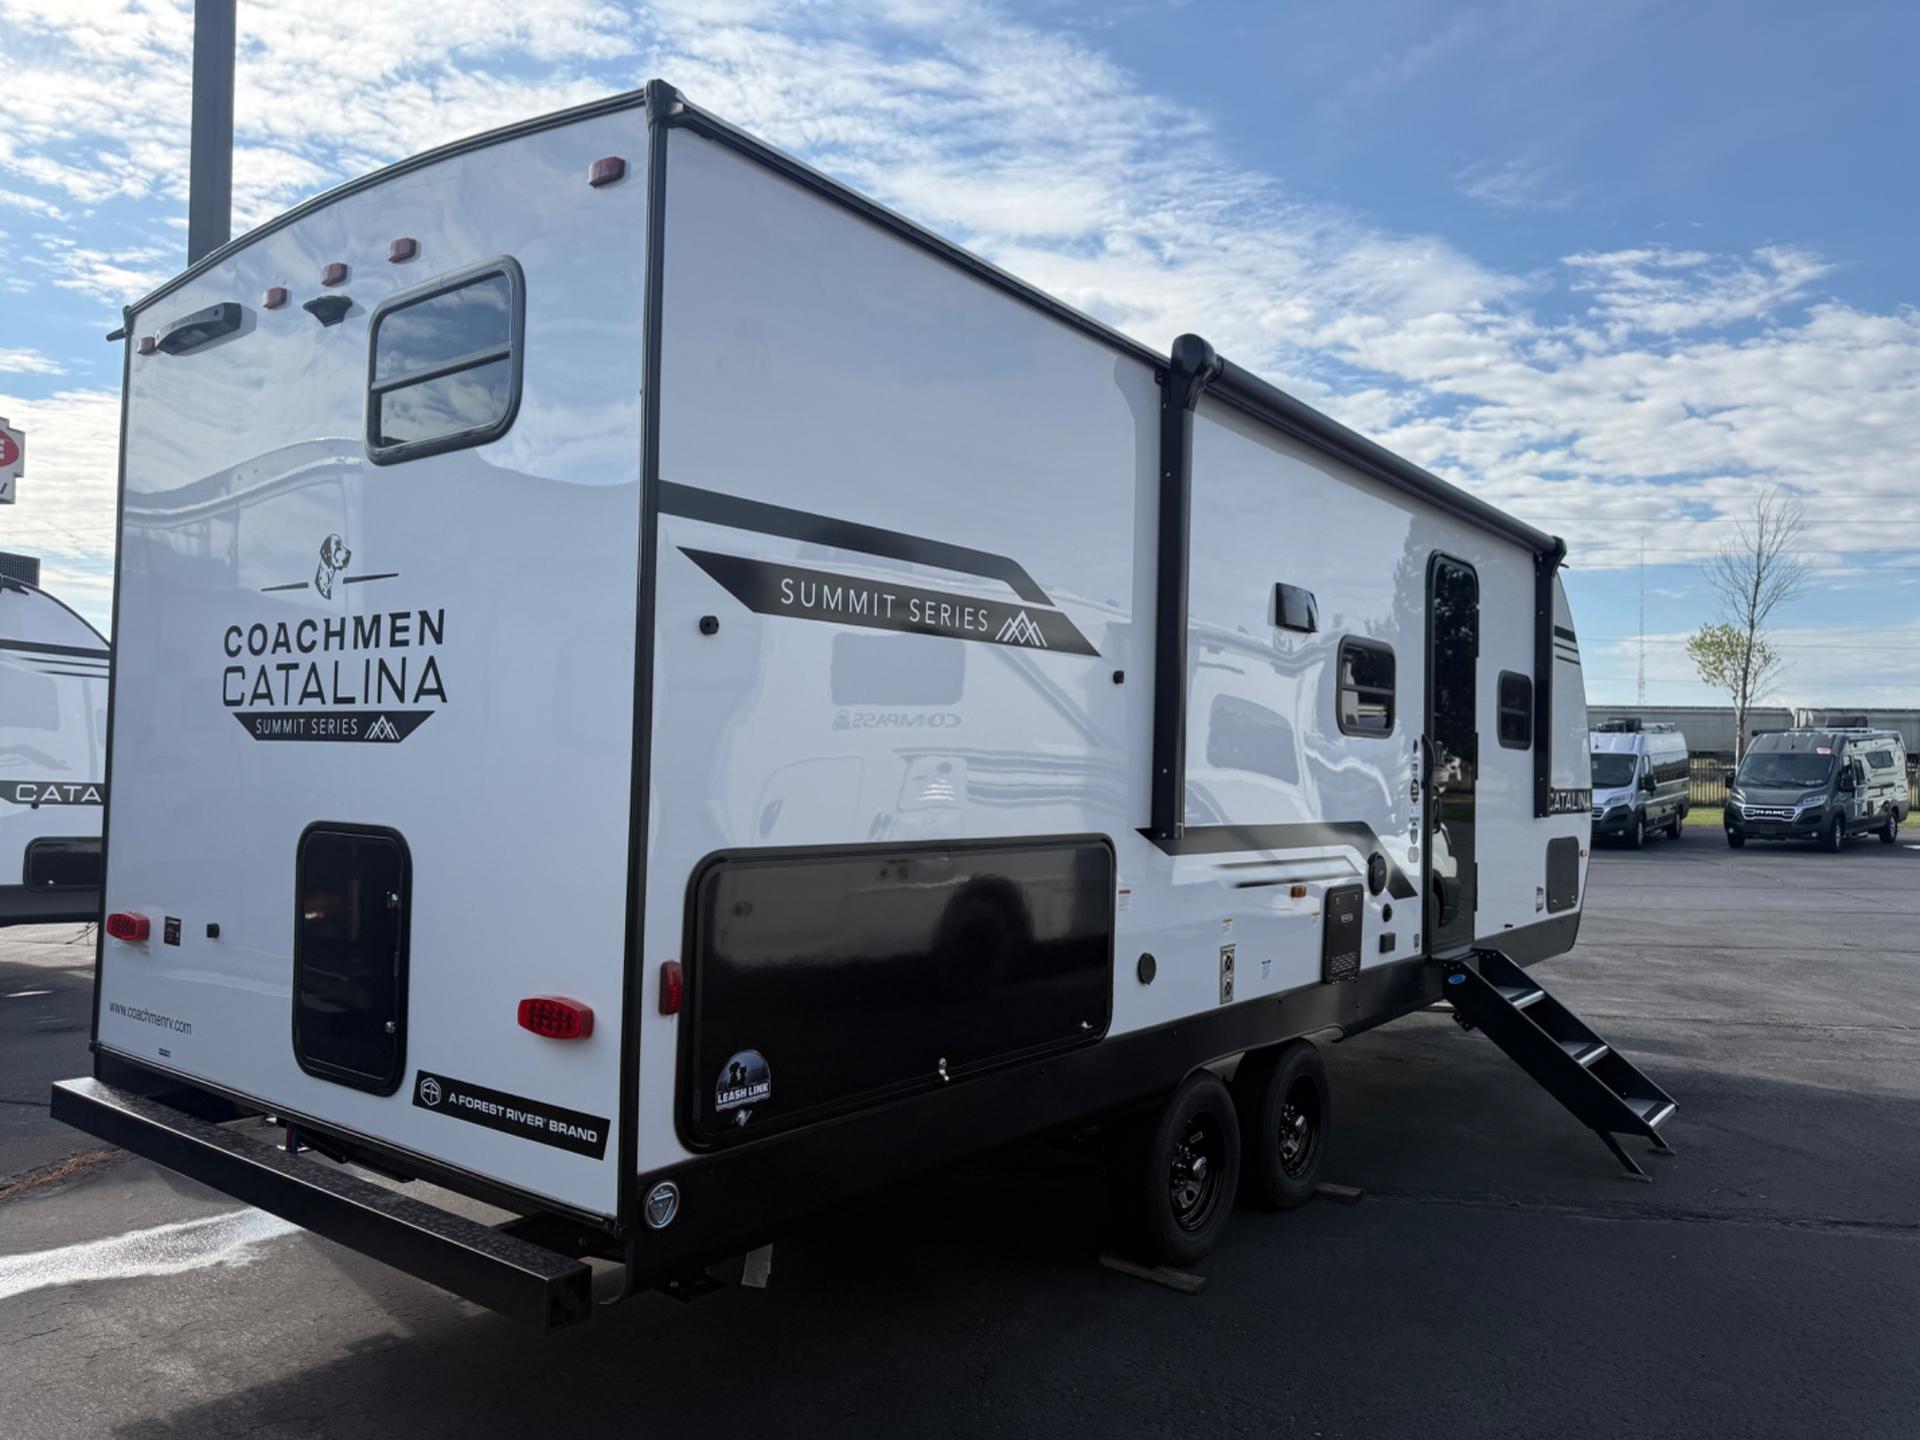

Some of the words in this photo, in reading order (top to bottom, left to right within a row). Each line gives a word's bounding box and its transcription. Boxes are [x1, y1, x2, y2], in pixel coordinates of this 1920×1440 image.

[780, 577, 896, 619] SUMMIT
[909, 598, 988, 632] SERIES
[223, 608, 445, 658] COACHMEN
[222, 655, 448, 707] CATALINA
[256, 718, 305, 735] SUMMIT
[311, 718, 358, 735] SERIES
[109, 1001, 192, 1035] www.coachmenrv.com
[448, 1092, 457, 1104] A
[458, 1095, 505, 1117] FOREST
[506, 1108, 544, 1128] RIVER
[549, 1120, 598, 1143] BRAND
[717, 1087, 747, 1104] LEASH
[749, 1083, 769, 1096] LINK
